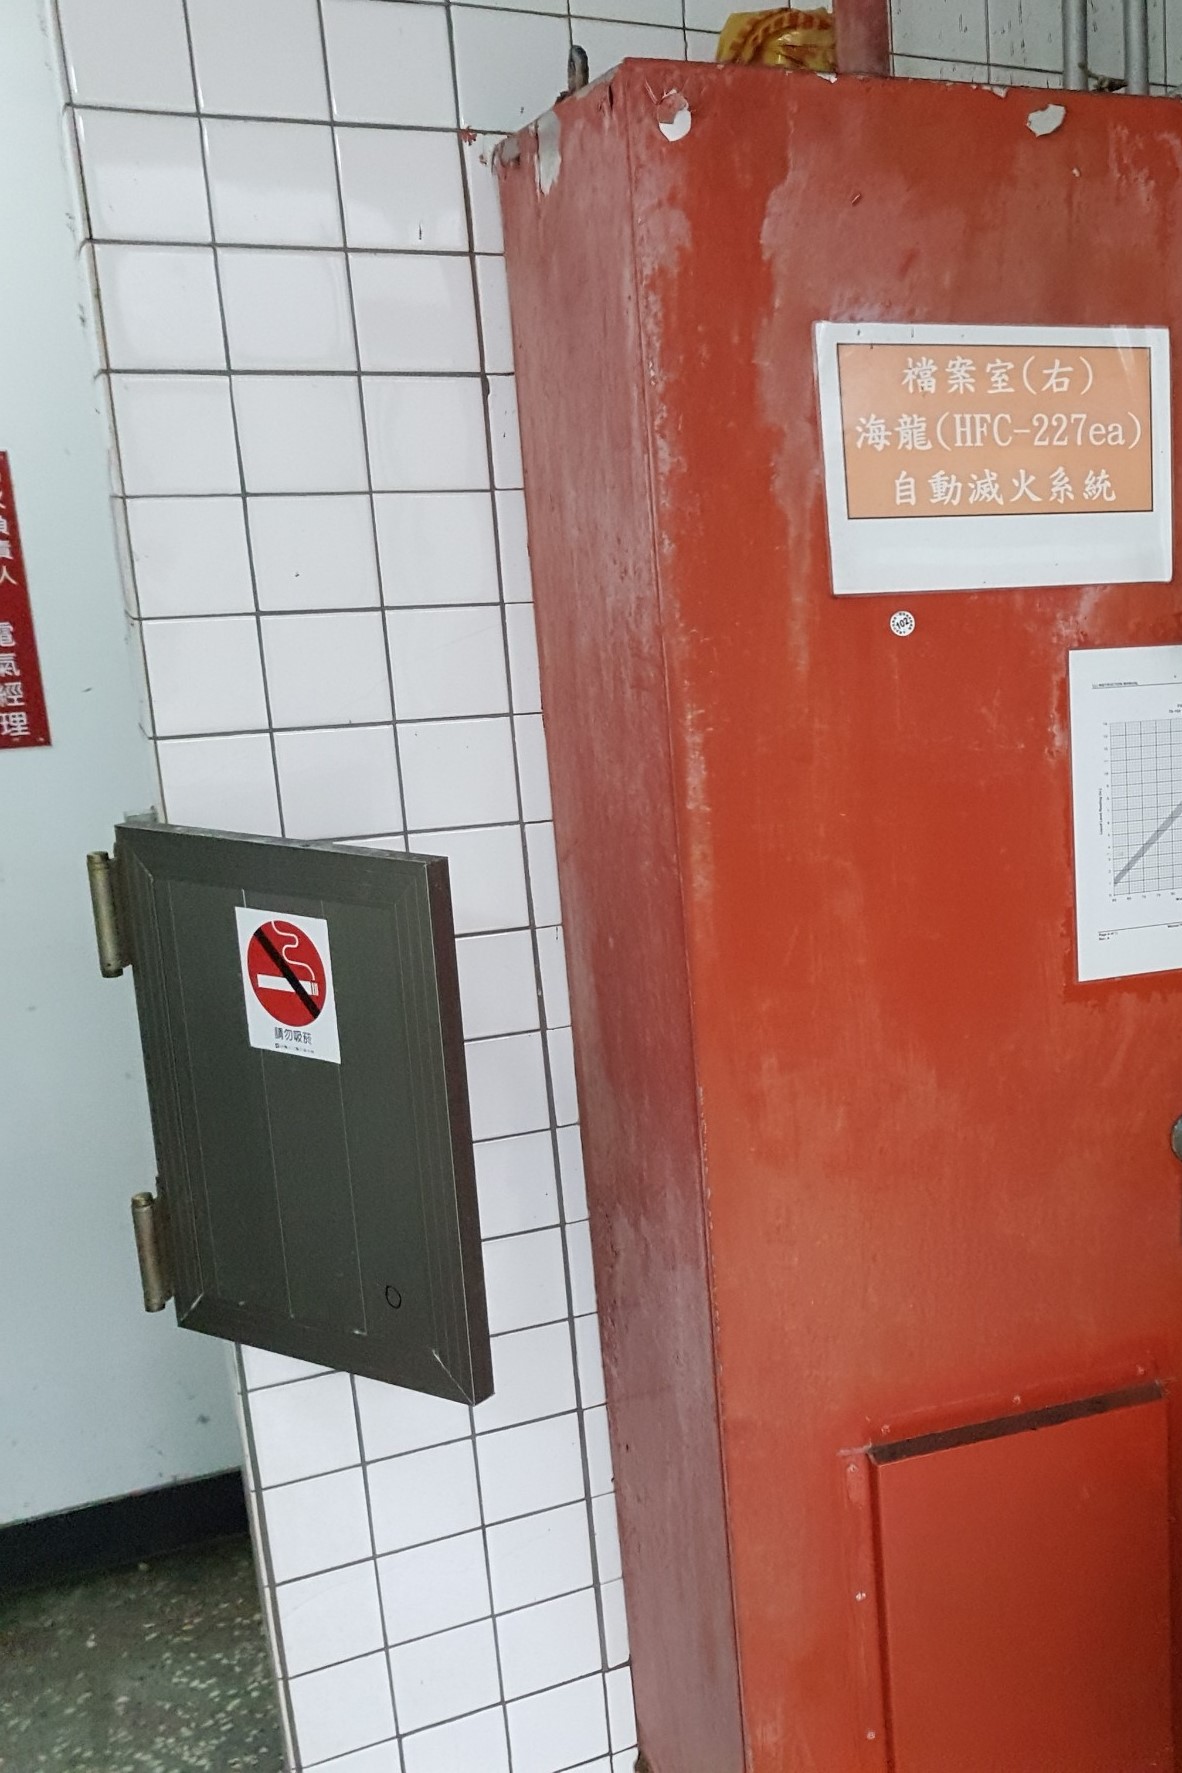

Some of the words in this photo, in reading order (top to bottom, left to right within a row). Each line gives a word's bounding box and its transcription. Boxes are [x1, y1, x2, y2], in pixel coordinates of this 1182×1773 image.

[901, 355, 1094, 396] 檔案室(右)
[854, 411, 1142, 452] 海龍(HFC-227ea)
[893, 465, 1117, 507] 自動滅火系統
[896, 617, 909, 629] 102
[274, 1026, 313, 1045] 請勿吸菸
